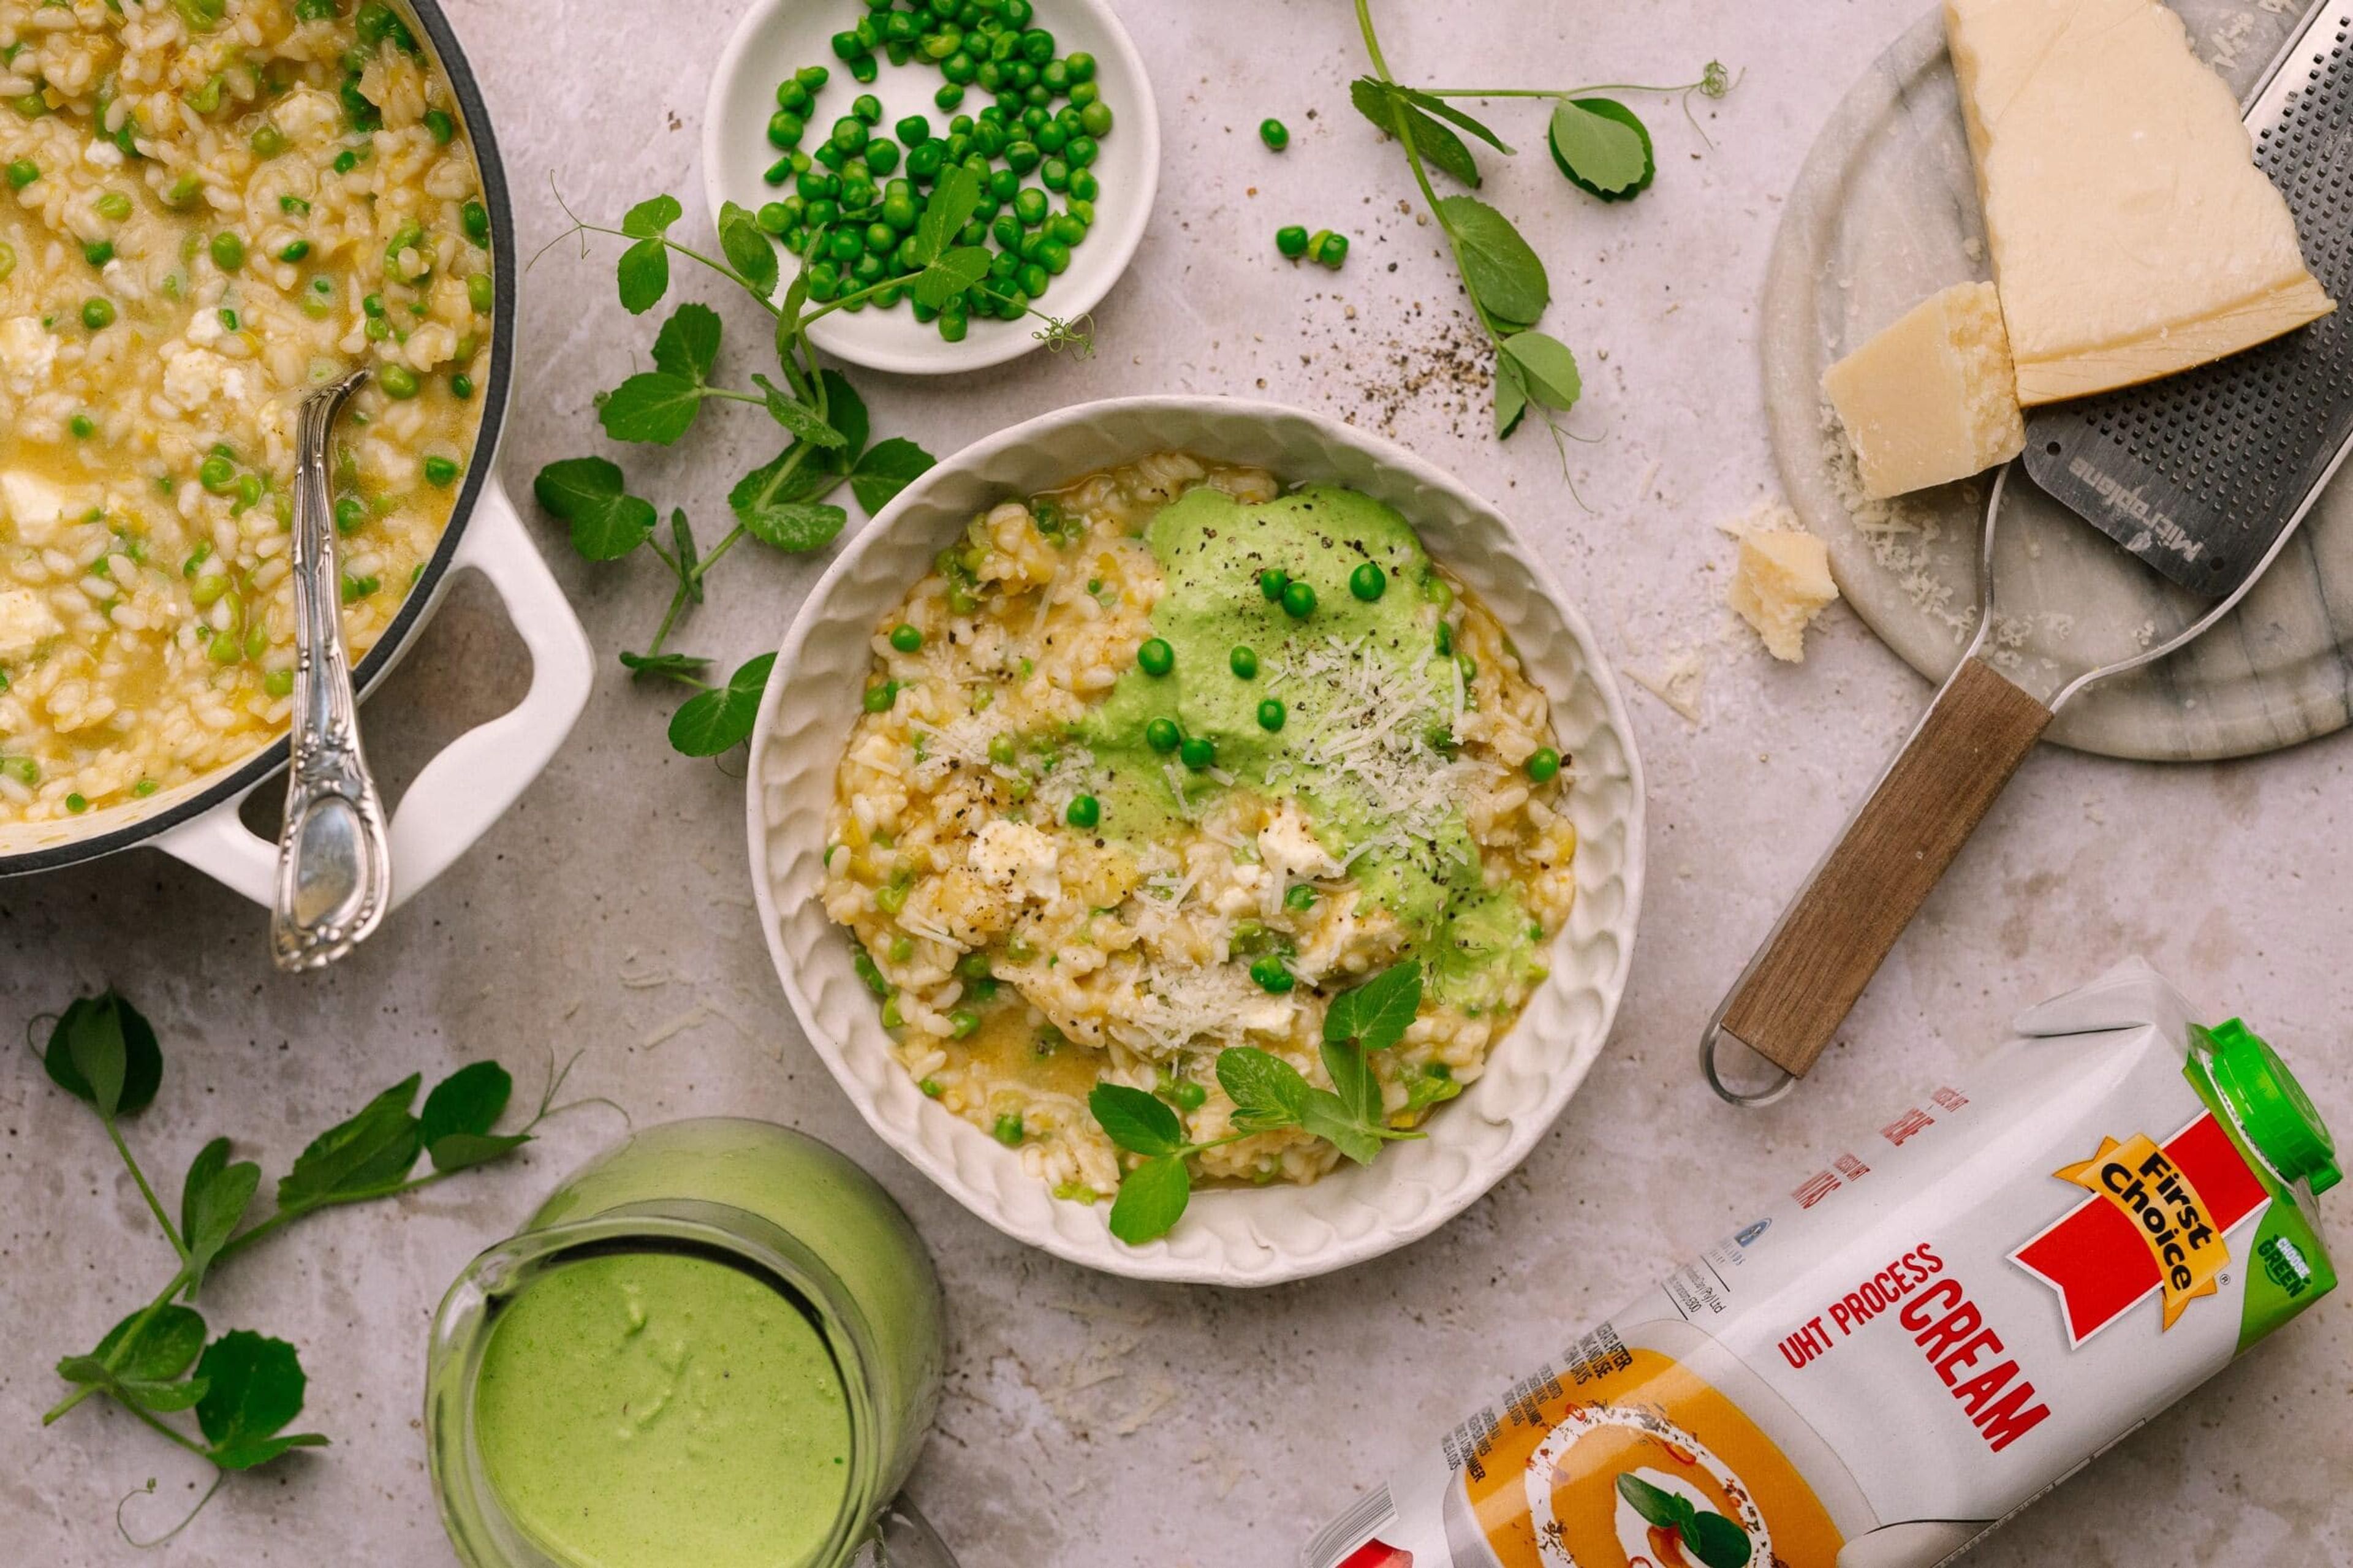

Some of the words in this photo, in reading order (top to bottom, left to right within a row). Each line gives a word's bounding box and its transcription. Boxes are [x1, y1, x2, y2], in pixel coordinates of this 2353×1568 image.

[2069, 458, 2204, 562] Microplane
[2101, 1162, 2192, 1291] Choice
[2139, 1152, 2213, 1250] First
[2257, 1239, 2306, 1298] GREEN
[2276, 1237, 2311, 1279] CHOOSE
[1710, 1297, 1727, 1314] Ltd
[1778, 1316, 1833, 1368] UHT
[1828, 1243, 1943, 1336] PROCESS
[1570, 1363, 1593, 1385] DAYS
[1592, 1358, 1613, 1379] USE
[1606, 1341, 1634, 1371] AFTER
[1900, 1279, 2051, 1453] CREAM
